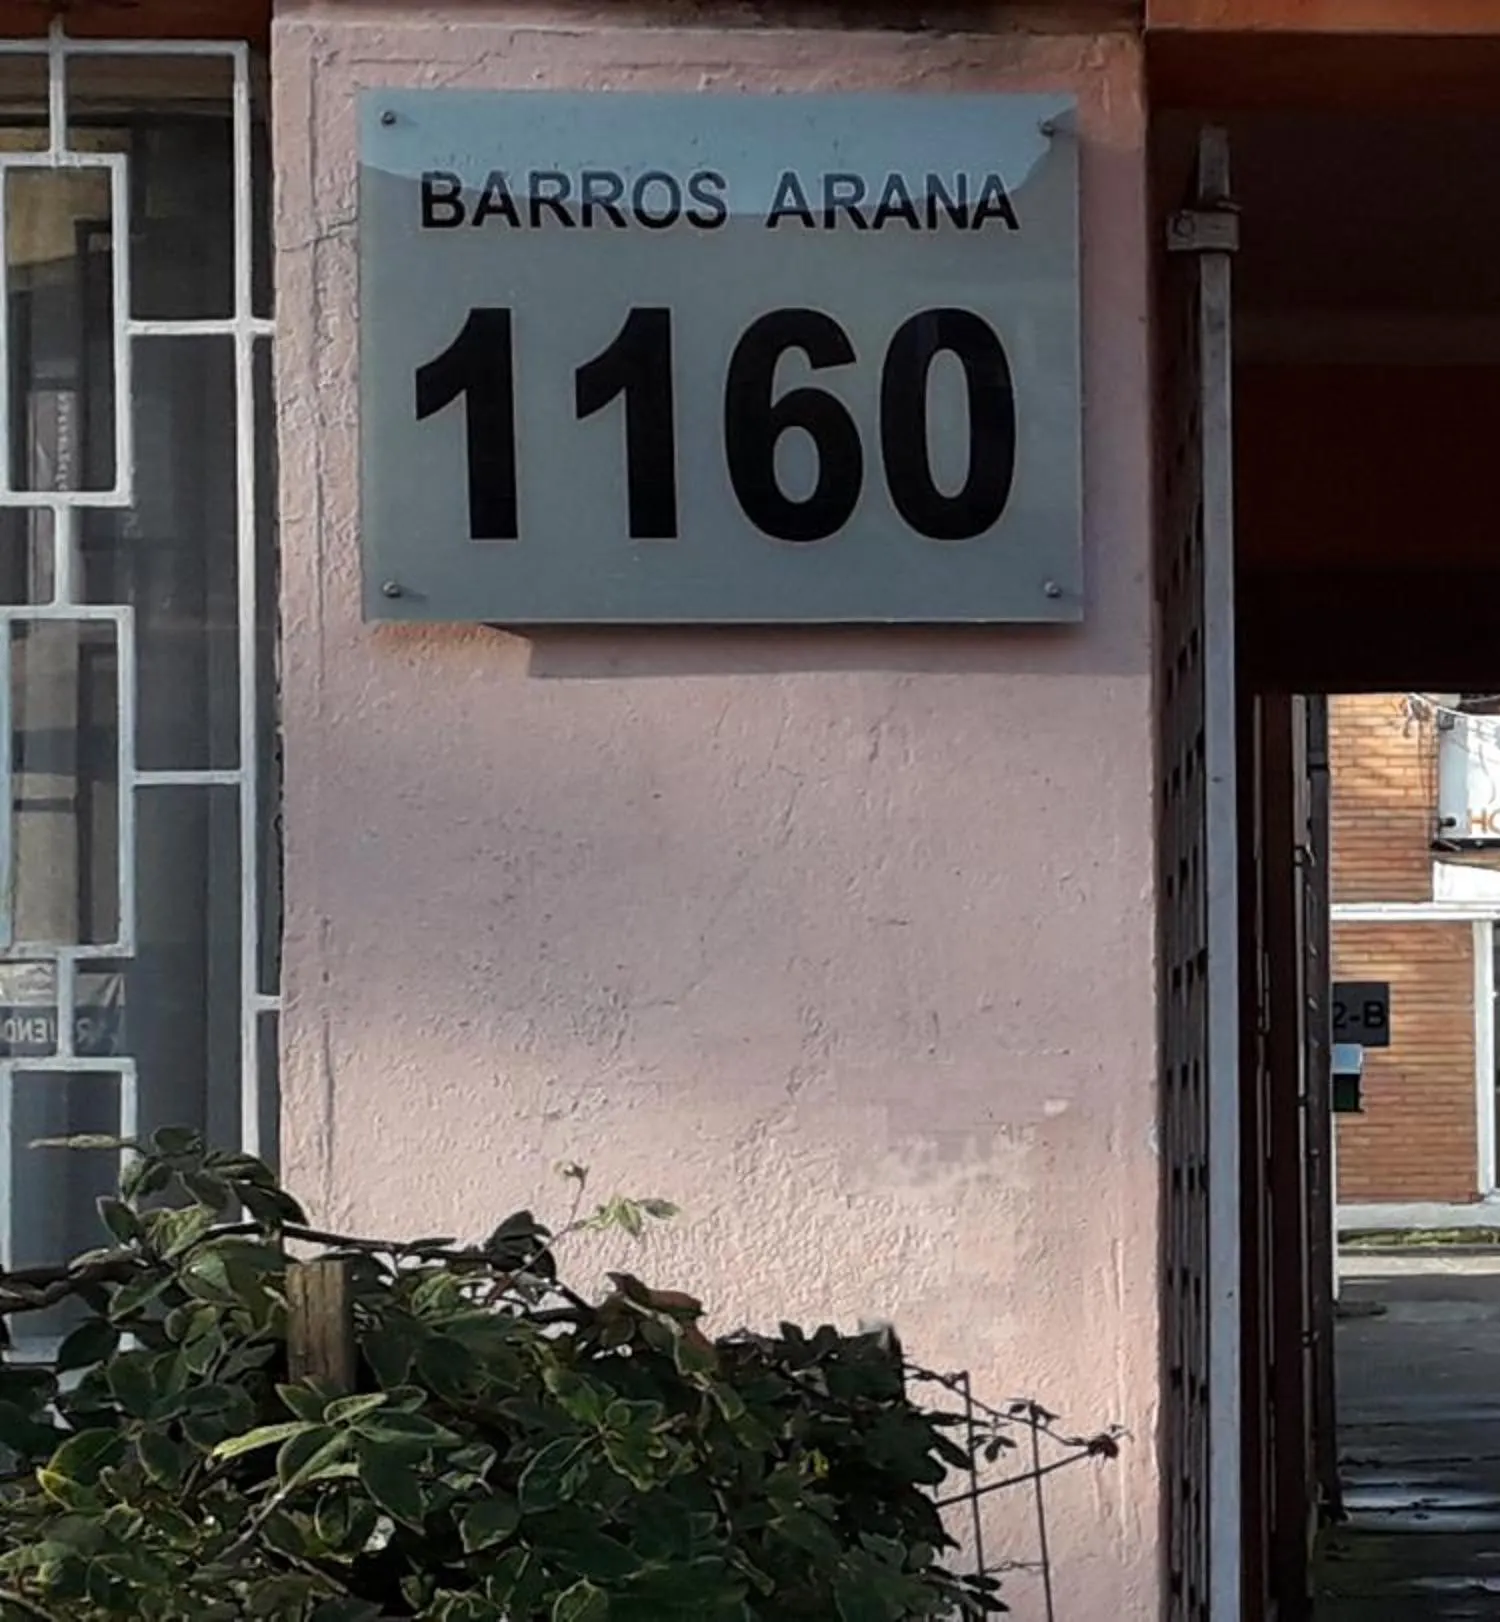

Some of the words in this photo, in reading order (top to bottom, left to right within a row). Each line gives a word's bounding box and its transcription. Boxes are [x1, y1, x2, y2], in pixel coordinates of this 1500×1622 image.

[420, 170, 728, 230] BARROS
[765, 170, 1020, 231] ARANA
[415, 307, 1017, 543] 1160
